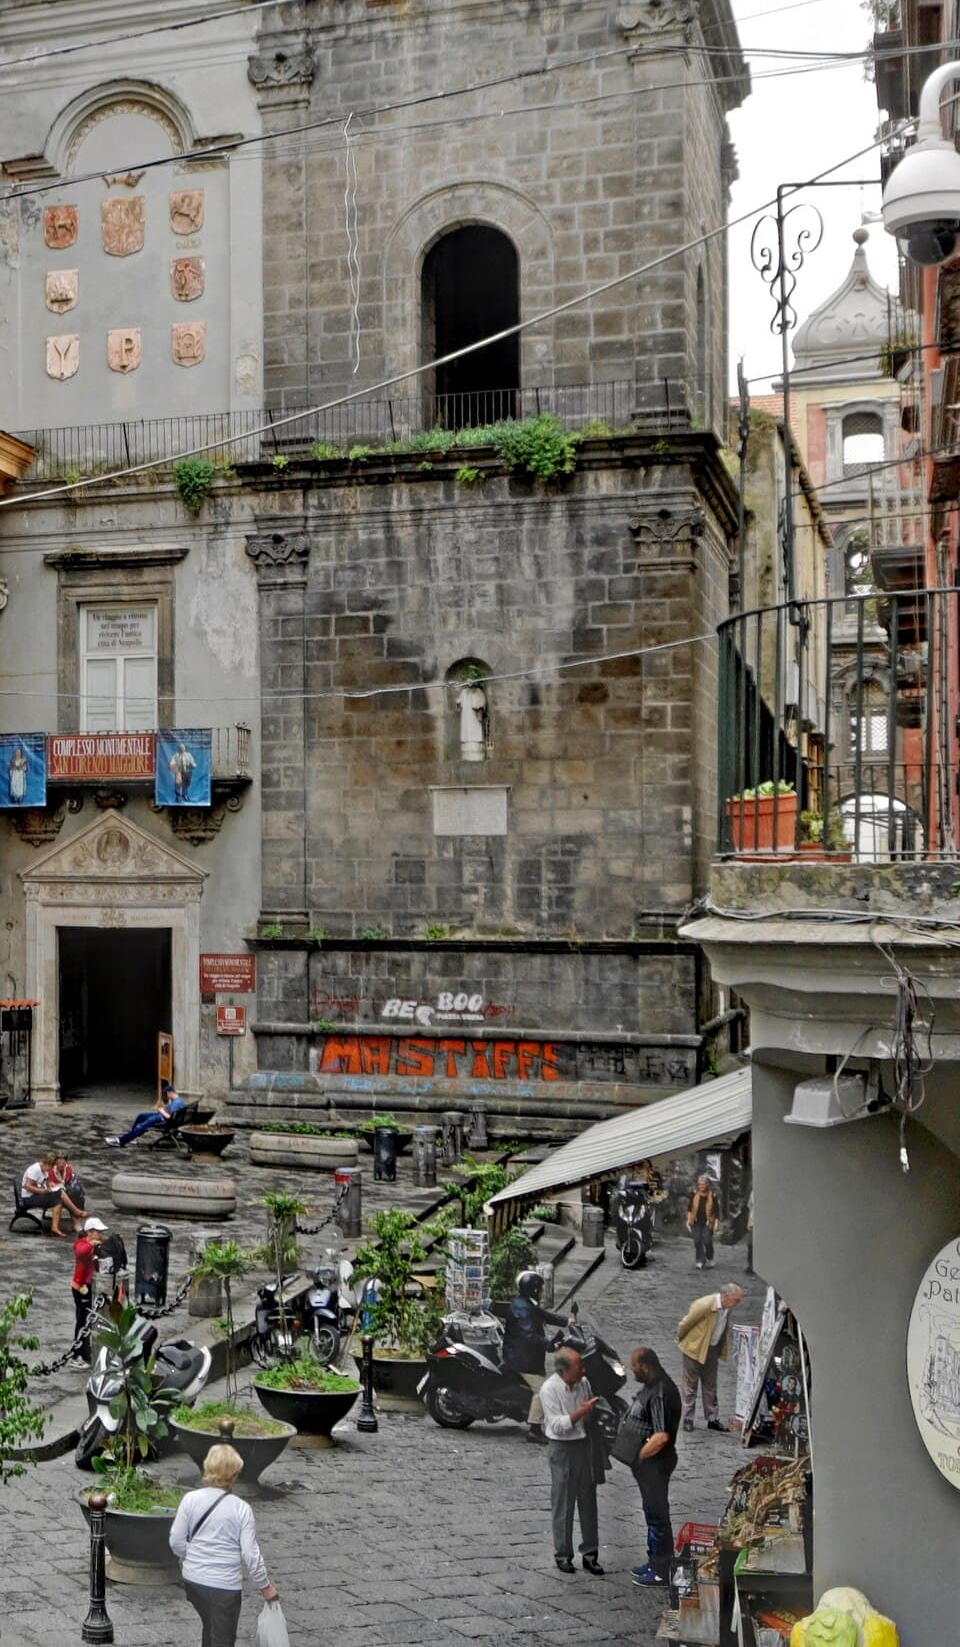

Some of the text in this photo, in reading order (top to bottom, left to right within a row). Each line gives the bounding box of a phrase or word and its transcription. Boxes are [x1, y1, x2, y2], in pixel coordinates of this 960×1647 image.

[53, 738, 94, 755] COMPLESSO
[95, 737, 151, 755] MONUMENTALE
[53, 754, 151, 773] SAN LORENZO MAGGIORE
